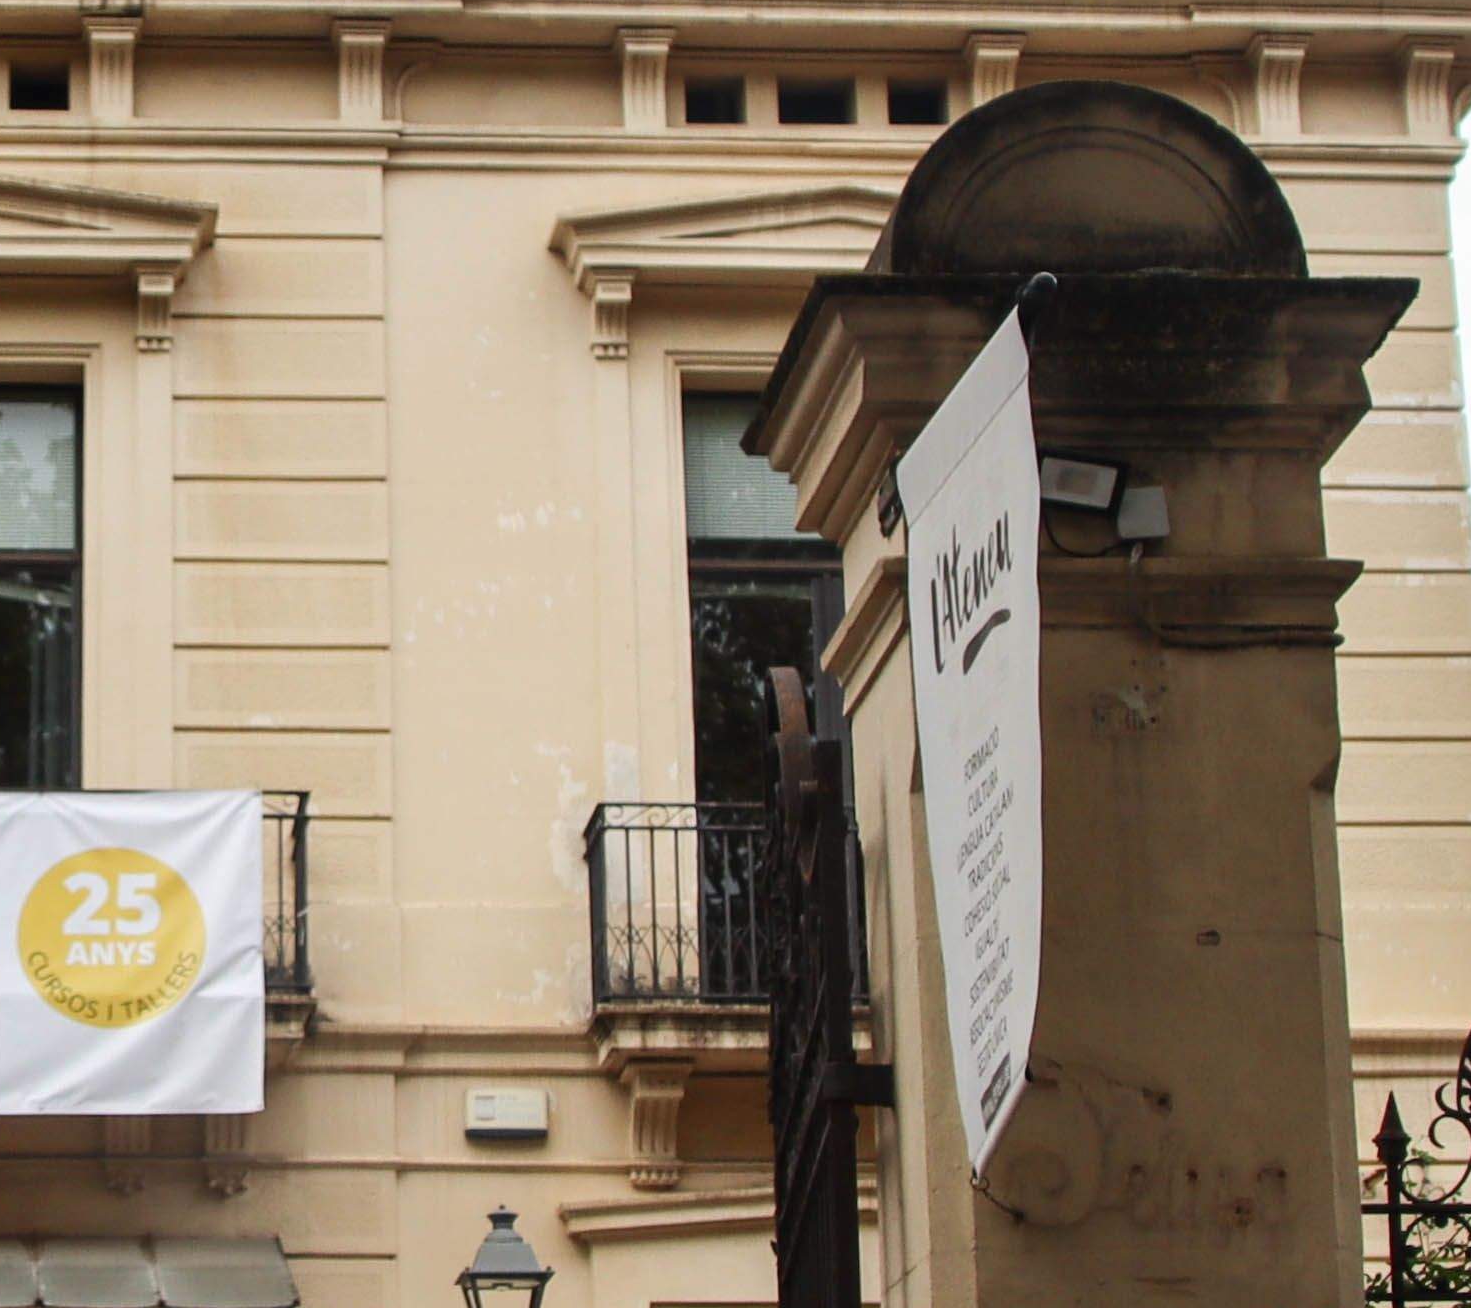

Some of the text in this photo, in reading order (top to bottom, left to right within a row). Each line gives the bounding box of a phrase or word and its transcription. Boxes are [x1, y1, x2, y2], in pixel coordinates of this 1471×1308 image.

[931, 510, 1014, 675] L'Ateneu
[61, 871, 163, 936] 25
[27, 950, 197, 1021] CURSOS I TALLERS
[66, 940, 156, 966] ANYS
